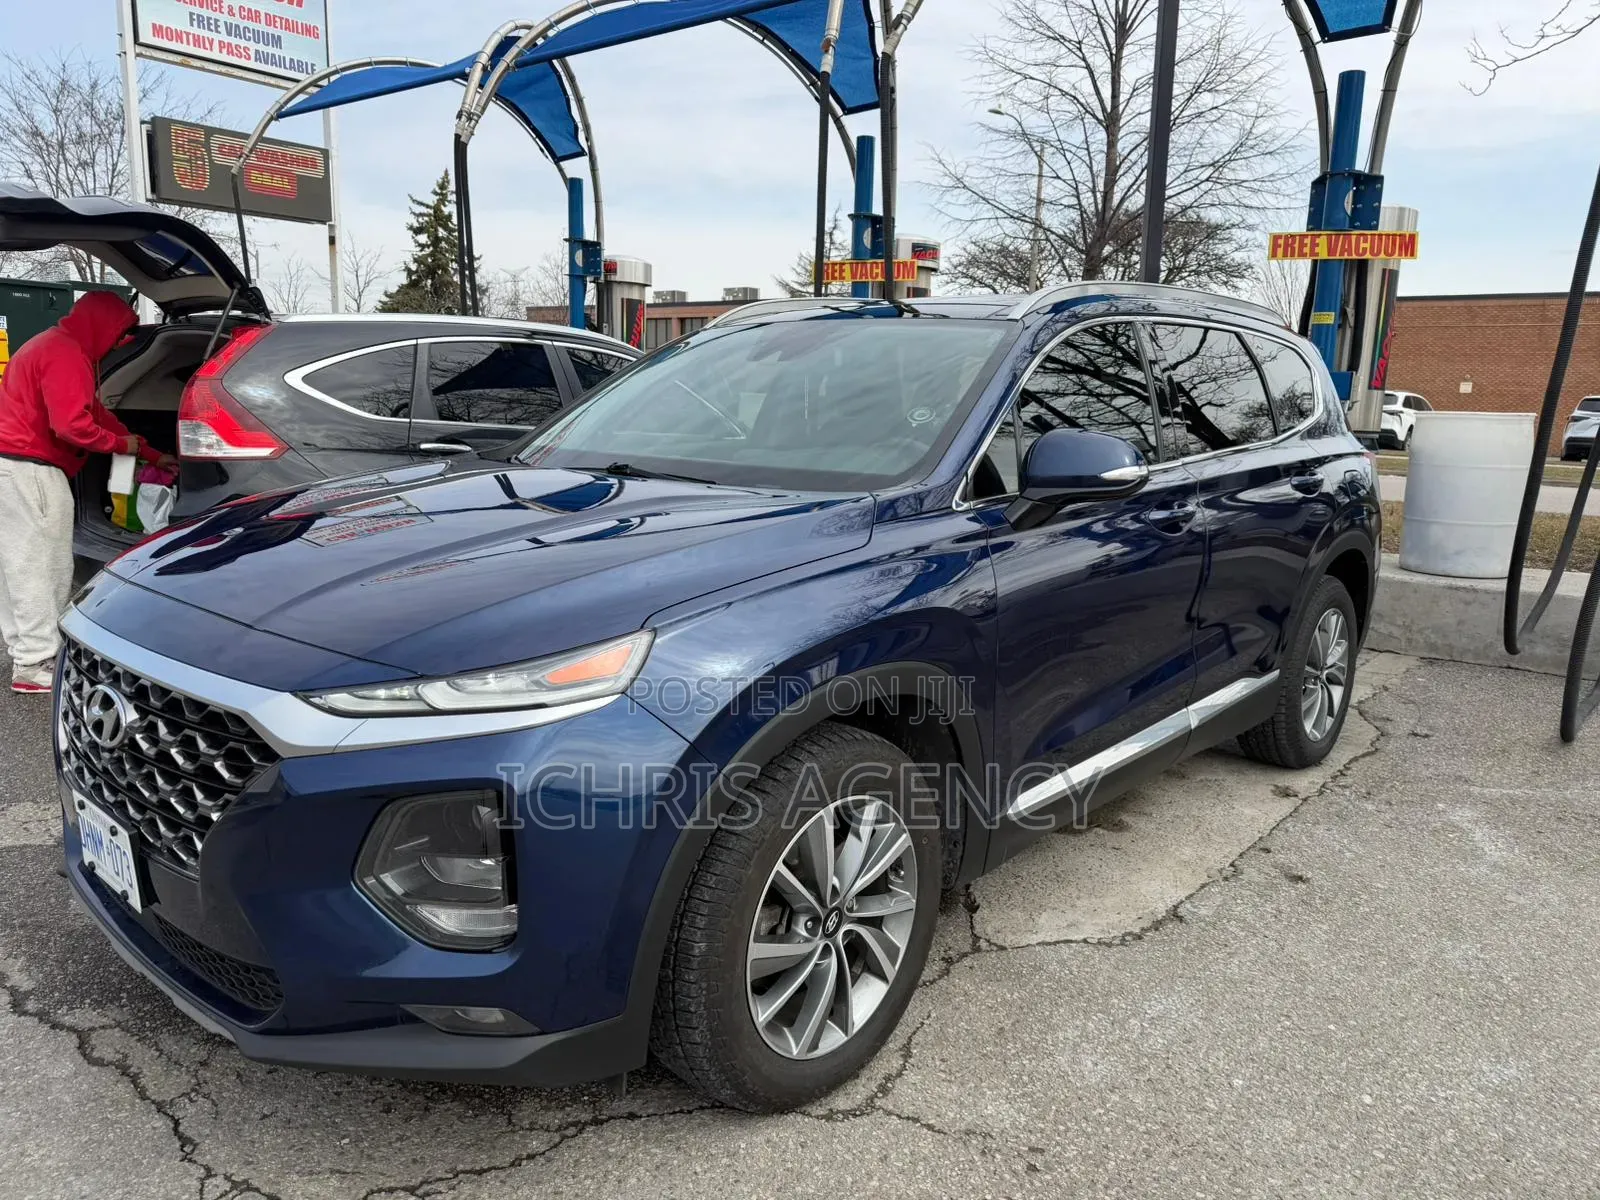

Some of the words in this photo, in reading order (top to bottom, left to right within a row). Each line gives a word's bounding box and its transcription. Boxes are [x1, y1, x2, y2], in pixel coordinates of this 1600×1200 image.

[175, 0, 225, 14] VICE
[227, 4, 236, 18] &
[238, 5, 262, 25] CAR
[264, 12, 320, 40] DETAILING
[188, 11, 221, 34] FREE
[223, 20, 283, 49] VACUUM
[151, 22, 214, 52] MONTHLY
[218, 39, 251, 61] PASS
[254, 48, 317, 76] AVAILABLE
[1271, 234, 1320, 258] FREE
[1326, 233, 1417, 258] VACUUM
[823, 262, 847, 281] REE
